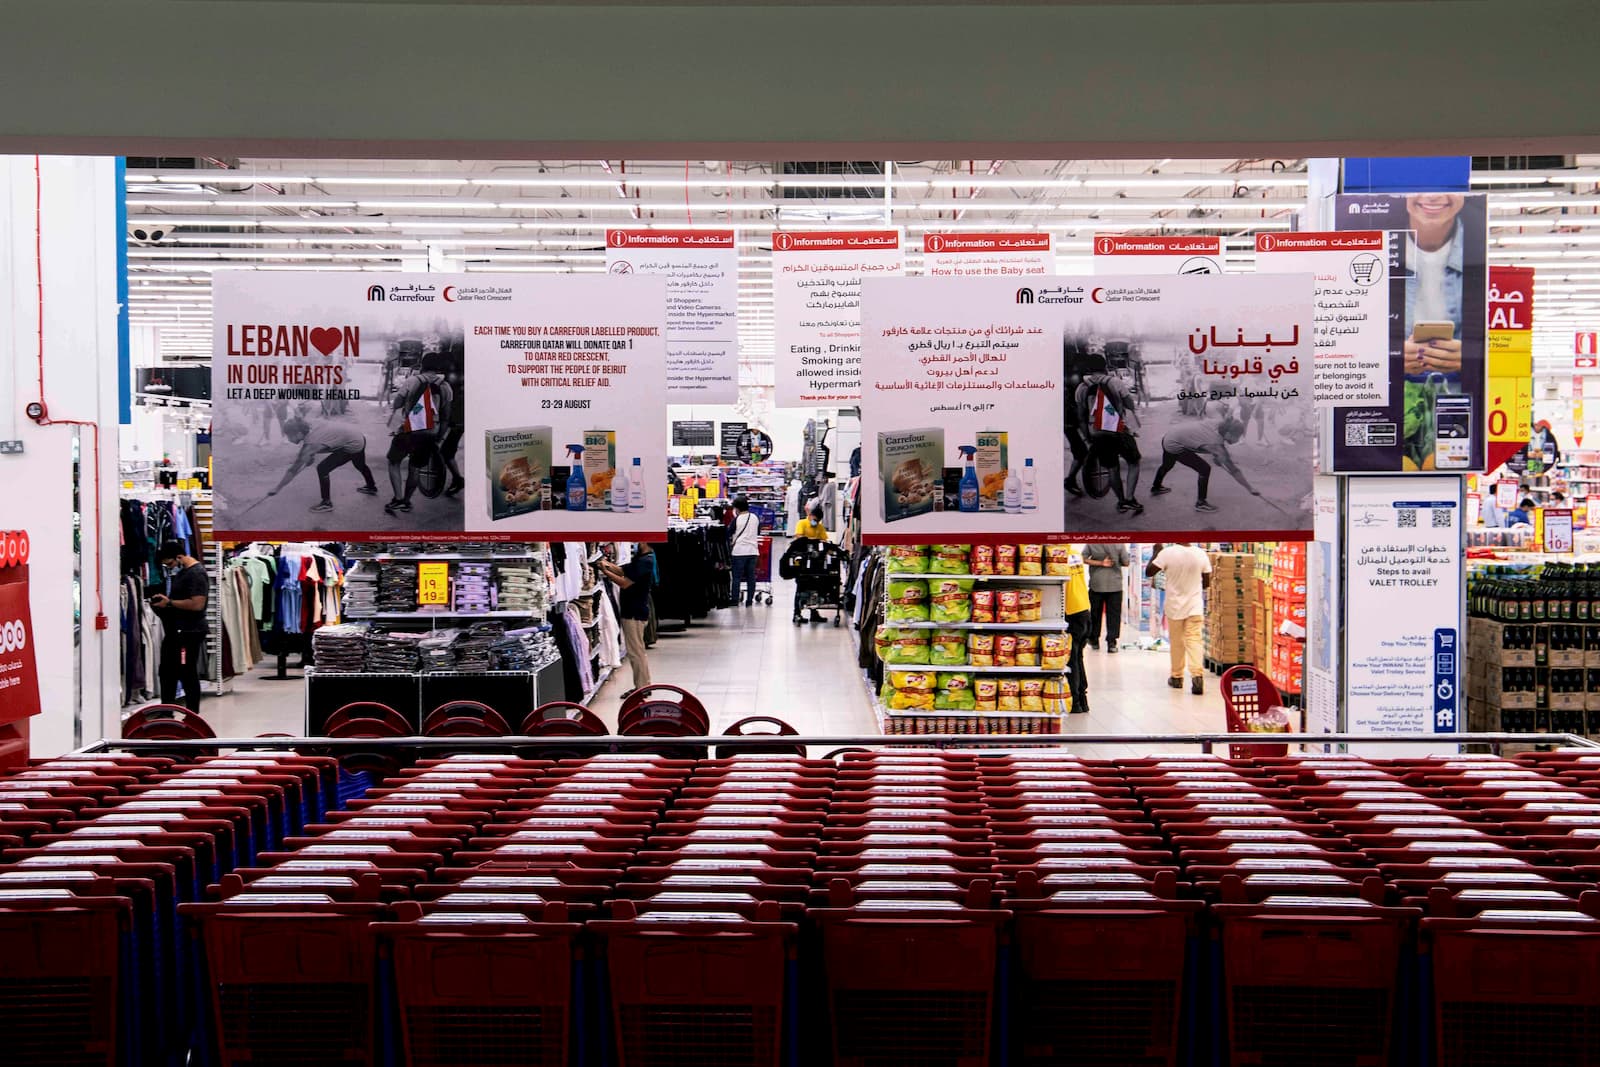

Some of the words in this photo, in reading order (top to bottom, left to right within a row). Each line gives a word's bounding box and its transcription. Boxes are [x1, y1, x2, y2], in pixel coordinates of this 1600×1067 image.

[628, 235, 679, 244] Information
[683, 235, 732, 244] استعلامات
[794, 238, 844, 246] Information
[848, 237, 897, 246] استعلامات
[945, 240, 995, 248] Information
[999, 239, 1048, 247] استعلامات
[1276, 239, 1327, 247] Information
[1331, 238, 1381, 247] استعلامات
[1115, 242, 1165, 250] Information
[1169, 242, 1218, 251] استعلامات
[783, 265, 809, 273] الكرام
[811, 264, 859, 273] المتسوقين
[861, 264, 884, 272] جميع
[932, 267, 951, 275] How
[954, 267, 961, 275] to
[984, 267, 998, 275] the
[1001, 266, 1023, 276] Baby
[1026, 266, 1045, 274] seat
[797, 279, 835, 288] والتدخين
[390, 284, 436, 293] كارفور
[1040, 286, 1084, 295] كارفور
[1323, 288, 1343, 296] عدم
[390, 293, 436, 302] Carrefour
[1038, 295, 1084, 304] Carrefour
[1318, 301, 1360, 310] الشخصية
[1336, 314, 1368, 323] التسوق
[474, 326, 493, 336] EACH
[494, 326, 511, 336] TIME
[512, 326, 527, 336] YOU
[528, 326, 542, 336] BUY
[544, 326, 549, 336] A
[550, 326, 590, 336] CARREFOUR
[592, 327, 626, 336] LABELLED
[882, 327, 909, 337] كارفور
[910, 326, 932, 336] علامة
[934, 326, 967, 336] منتجات
[969, 326, 983, 336] من
[984, 324, 994, 338] أي
[995, 326, 1024, 335] شرائك
[1026, 326, 1043, 335] عند
[1330, 327, 1359, 336] للضياع
[1188, 325, 1299, 354] لبنان
[500, 340, 541, 350] CARREFOUR
[542, 340, 565, 350] QATAR
[566, 340, 582, 350] WILL
[584, 340, 610, 350] DONATE
[612, 340, 626, 350] QAR
[629, 339, 633, 350] 1
[908, 340, 932, 352] قطري
[934, 340, 951, 350] ريال
[966, 340, 991, 350] التبرع
[992, 342, 1019, 350] سيتم
[790, 345, 821, 355] Eating
[524, 352, 533, 361] TO
[535, 352, 557, 361] QATAR
[558, 352, 572, 361] RED
[802, 356, 843, 366] Smoking
[953, 354, 977, 363] الأحمر
[978, 354, 1007, 362] للهلال
[508, 365, 516, 374] TO
[518, 365, 549, 374] SUPPORT
[550, 365, 563, 374] THE
[565, 365, 589, 374] PEOPLE
[592, 366, 601, 374] OF
[602, 365, 627, 374] BEIRUT
[955, 366, 973, 377] أهل
[1204, 356, 1263, 379] قلوبنا
[1268, 356, 1299, 383] في
[228, 364, 243, 384] IN
[248, 364, 278, 384] OUR
[283, 365, 343, 385] HEARTS
[796, 368, 833, 377] allowed
[927, 368, 953, 377] بيروت
[975, 368, 999, 377] لدعم
[1322, 373, 1367, 381] belongings
[522, 378, 539, 387] WITH
[540, 378, 571, 387] CRITICAL
[573, 378, 596, 387] RELIEF
[598, 378, 611, 387] AID.
[875, 380, 913, 390] الأساسية
[915, 381, 944, 392] الإغاثية
[946, 382, 1002, 391] والمستلزمات
[1004, 381, 1055, 390] بالمساعدات
[227, 388, 243, 400] LET
[245, 389, 251, 400] A
[254, 389, 277, 400] DEEP
[278, 389, 310, 400] WOUND
[312, 389, 324, 400] BE
[326, 389, 360, 401] HEALED
[1176, 390, 1207, 400] عميق
[1210, 388, 1236, 400] لجرح
[1281, 388, 1299, 400] كن
[542, 400, 563, 409] 23-29
[564, 400, 591, 409] AUGUST
[930, 402, 962, 412] أغسطس
[493, 432, 533, 444] Carrefour
[585, 437, 606, 446] BIO
[885, 434, 925, 445] Carrefour
[978, 438, 999, 447] BIO
[1362, 546, 1374, 554] من
[1376, 545, 1415, 554] الإستفادة
[1416, 545, 1447, 553] خطوات
[1357, 556, 1388, 566] للمنازل
[1389, 556, 1426, 566] التوصيل
[1377, 568, 1400, 576] Steps
